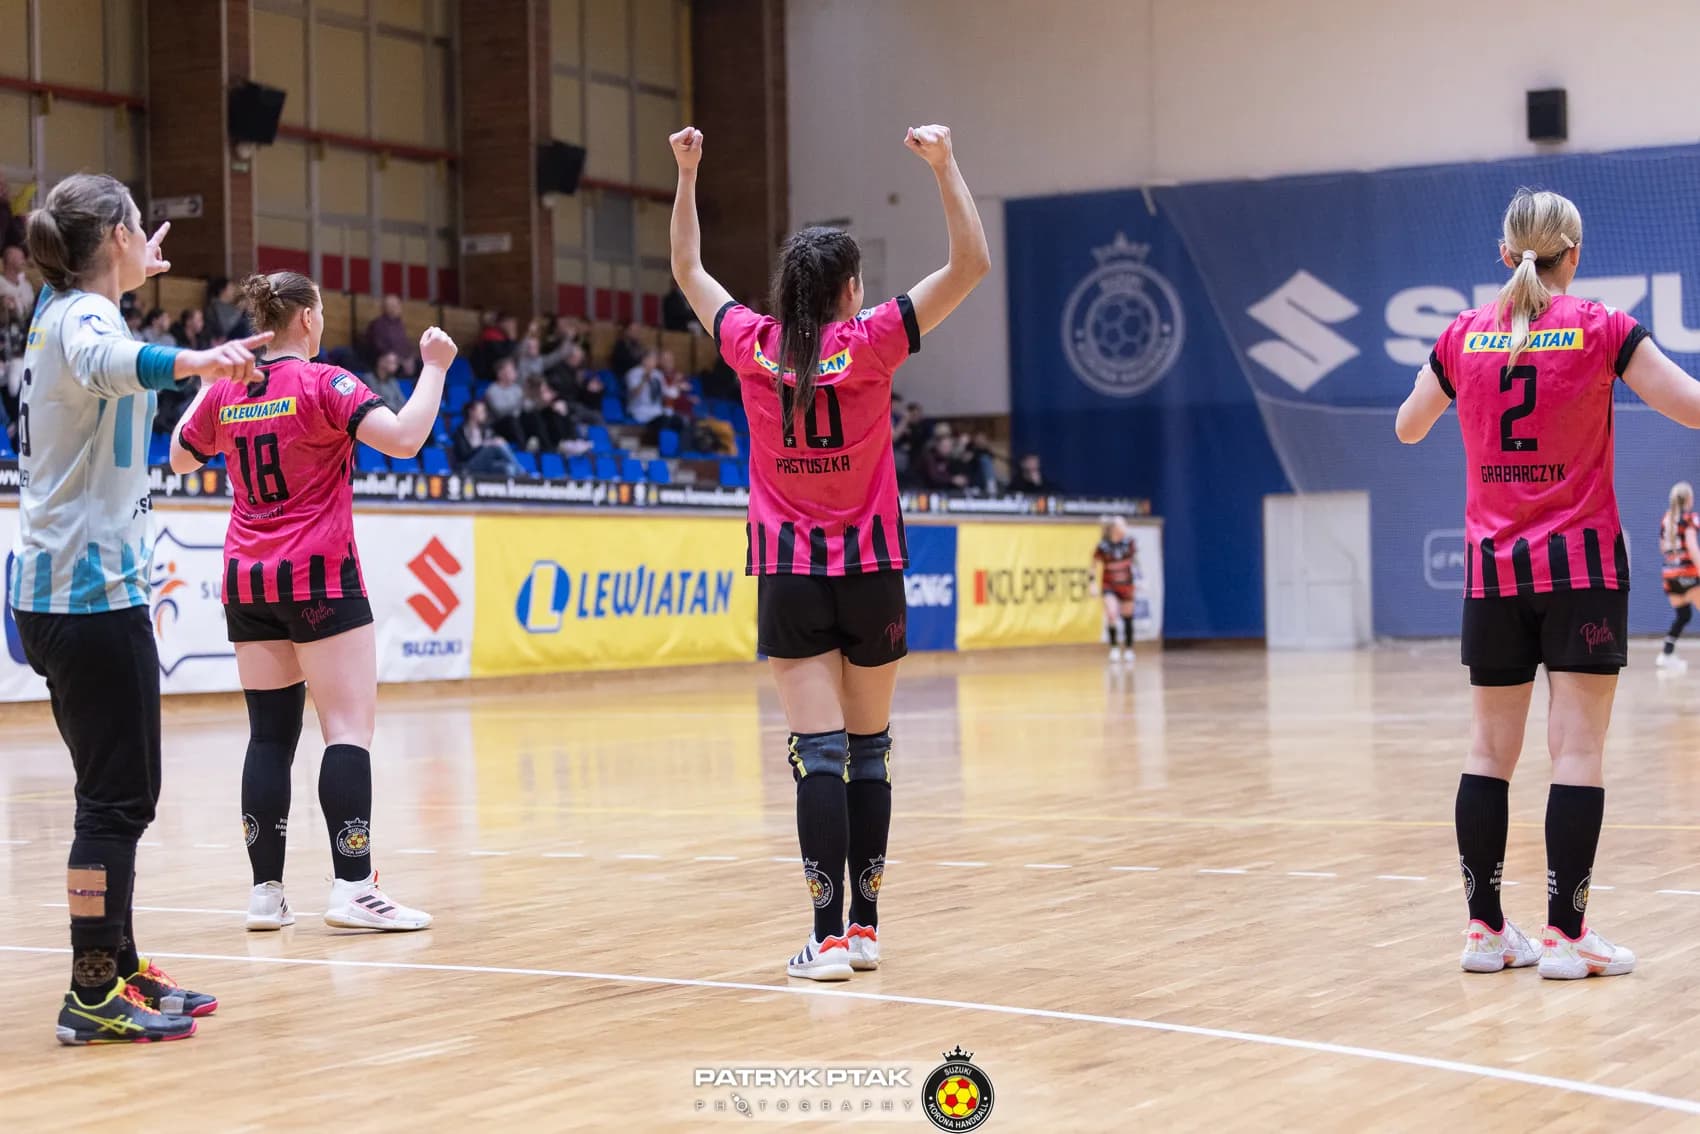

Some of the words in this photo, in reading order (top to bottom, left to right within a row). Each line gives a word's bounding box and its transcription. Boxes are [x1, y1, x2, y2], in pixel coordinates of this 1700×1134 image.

[1488, 331, 1576, 350] LEATAN
[233, 400, 290, 420] LEWIATAN
[1500, 365, 1538, 451] 2
[235, 432, 289, 505] 18
[776, 455, 850, 474] PASTUSZKA
[1481, 463, 1567, 483] GRABARCZYK
[577, 563, 734, 618] LEWIATAN
[987, 567, 1093, 605] KOLPORTER
[402, 640, 463, 657] SUZUKI
